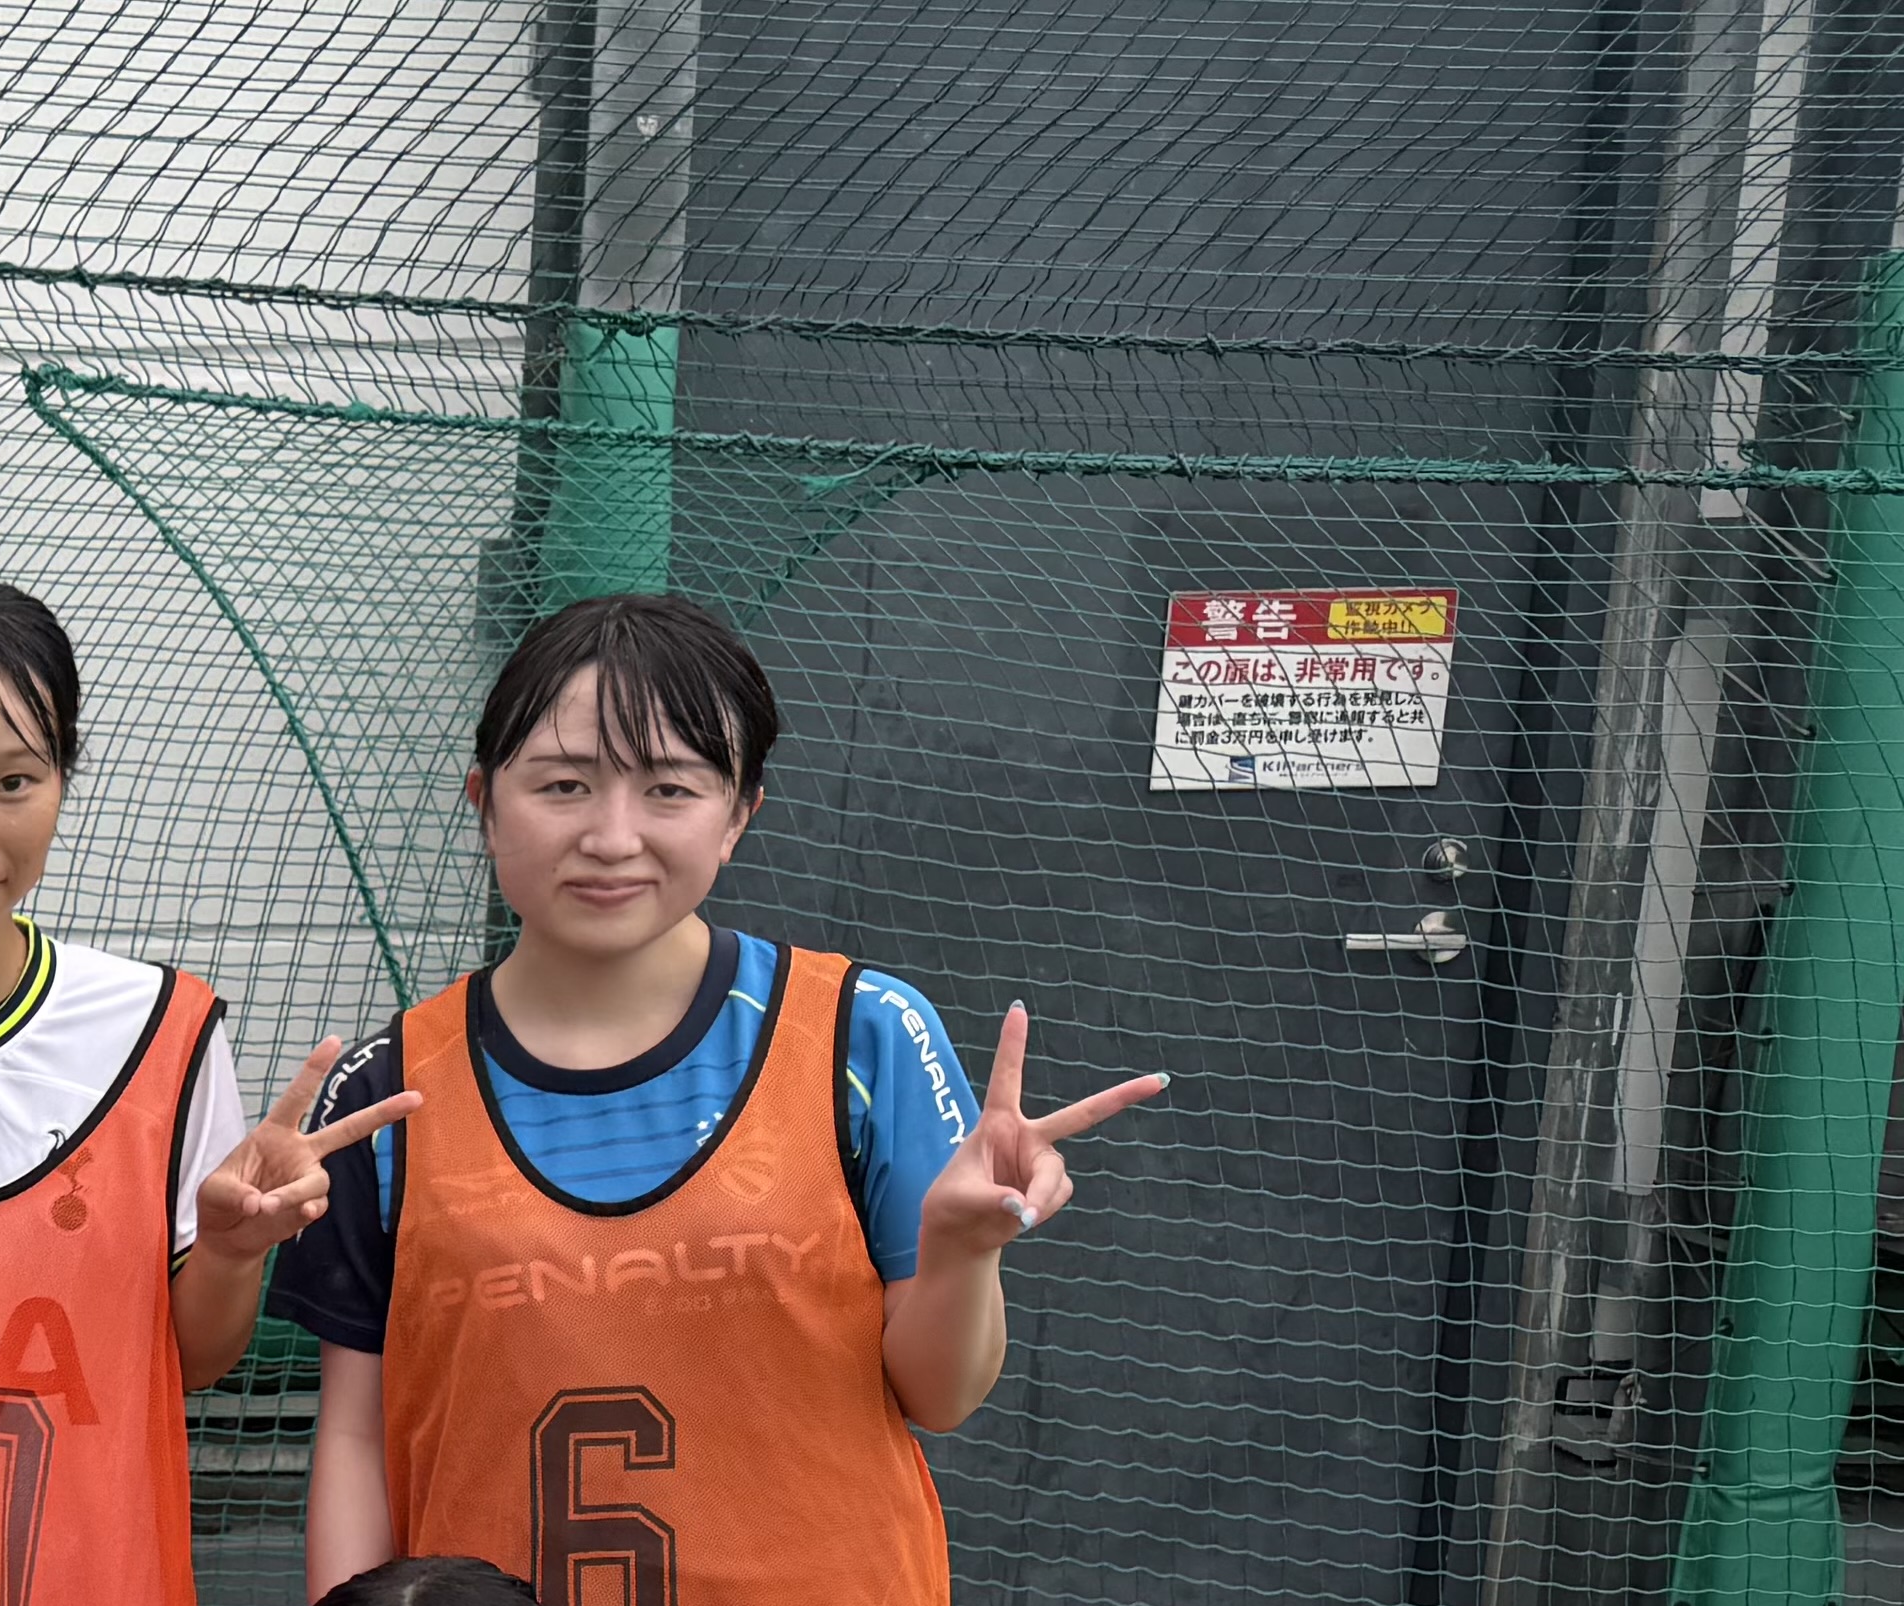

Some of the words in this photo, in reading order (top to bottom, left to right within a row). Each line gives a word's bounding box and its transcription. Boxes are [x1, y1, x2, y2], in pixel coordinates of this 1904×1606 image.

[1201, 599, 1297, 640] 警告
[880, 989, 966, 1144] PENALTY
[428, 1232, 822, 1313] PENALTY
